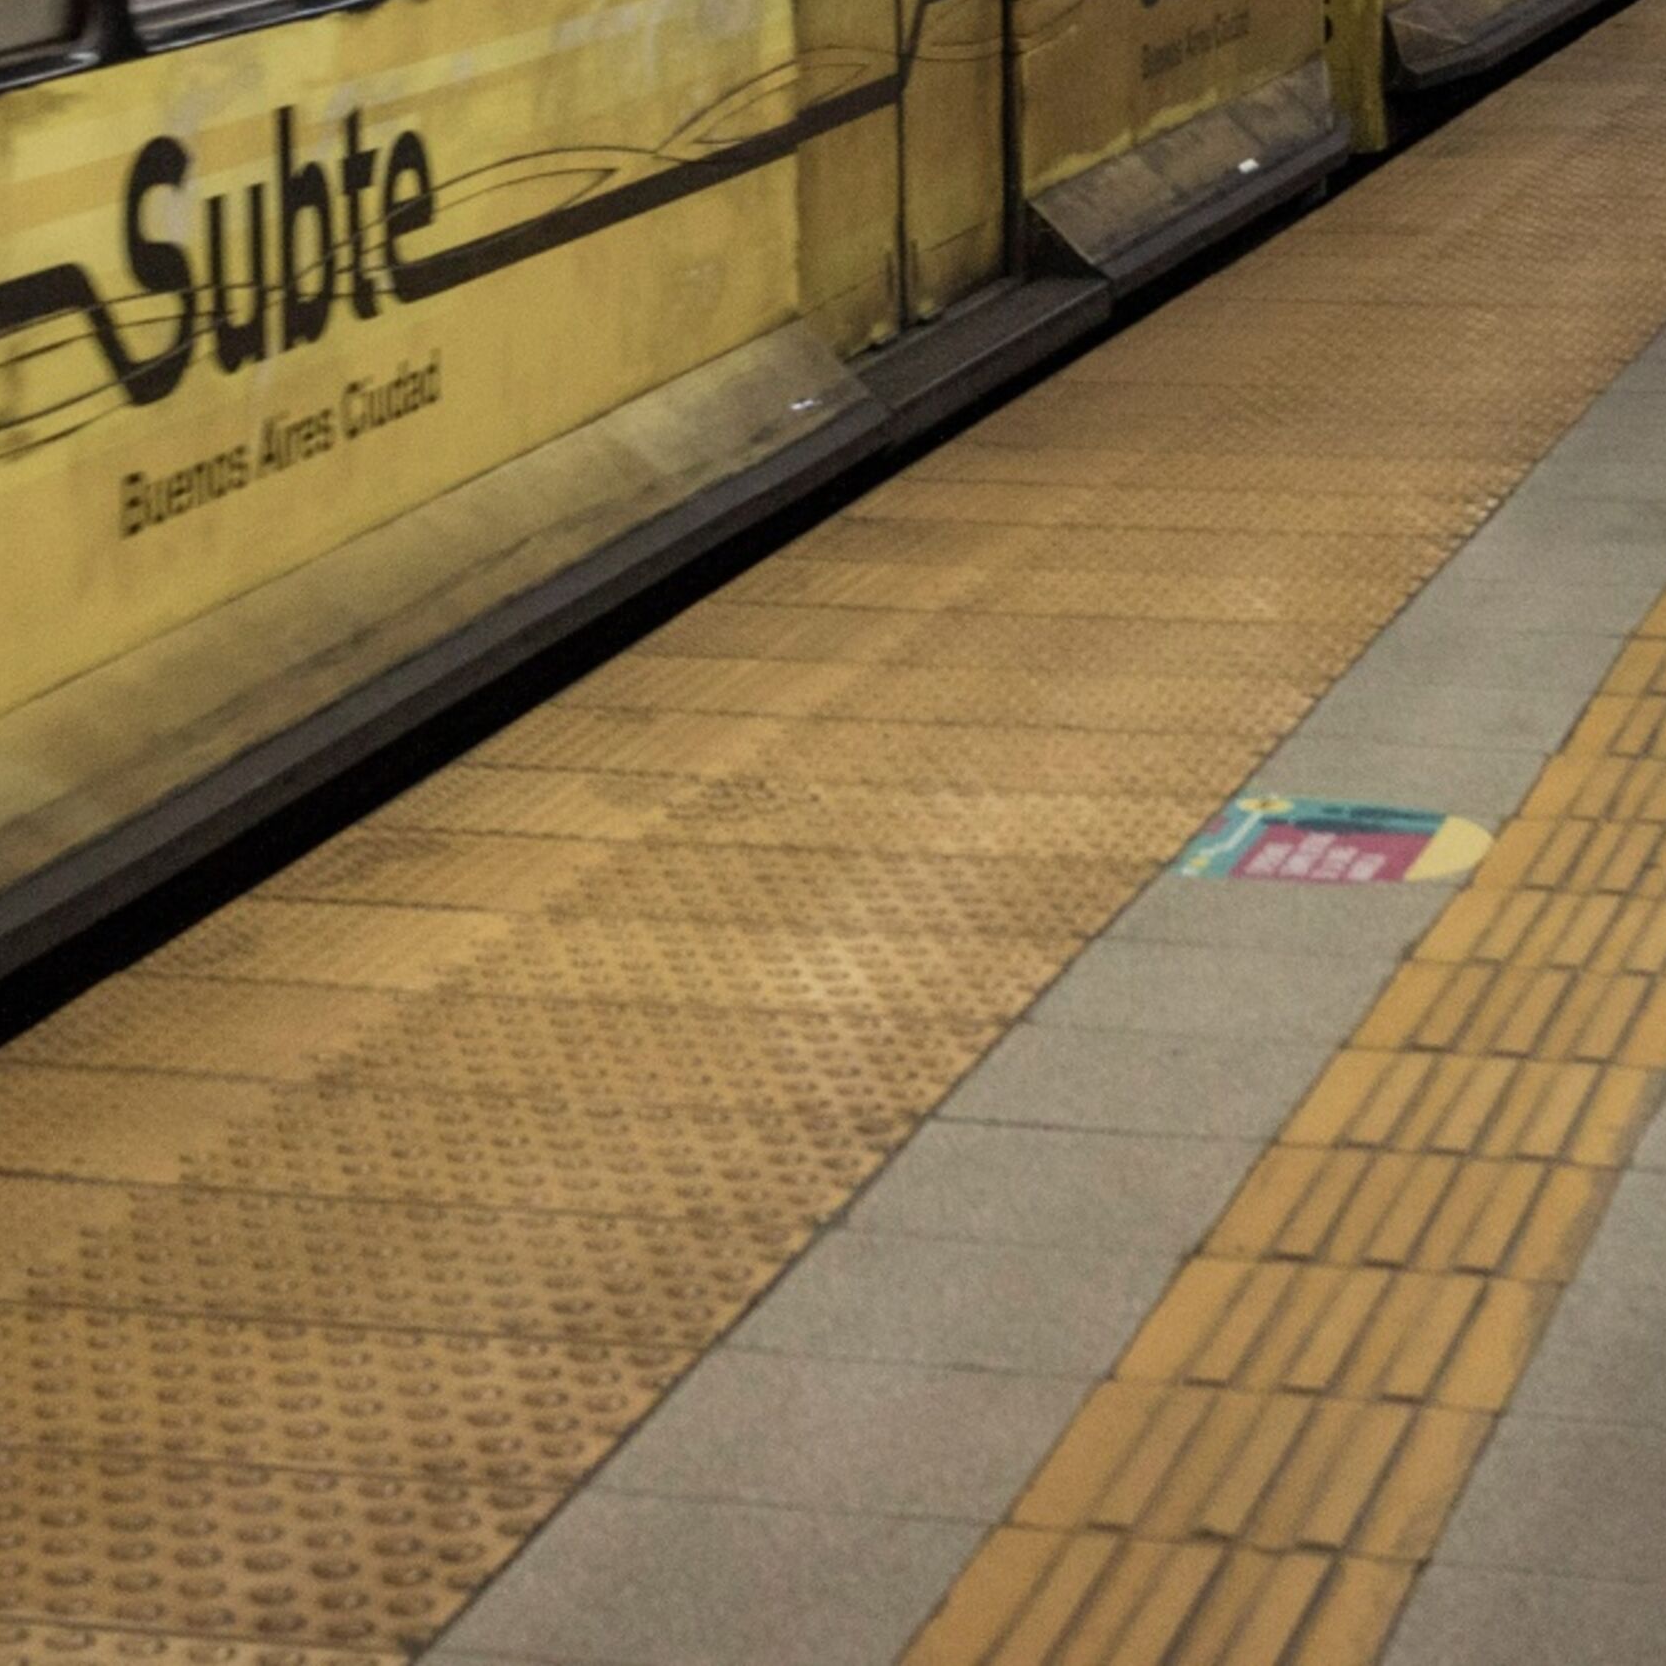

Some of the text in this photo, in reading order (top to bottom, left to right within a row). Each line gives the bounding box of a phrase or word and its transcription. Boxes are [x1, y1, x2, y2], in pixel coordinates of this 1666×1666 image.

[124, 105, 435, 406] Subte
[122, 357, 442, 537] Buenos Aires Ciudad
